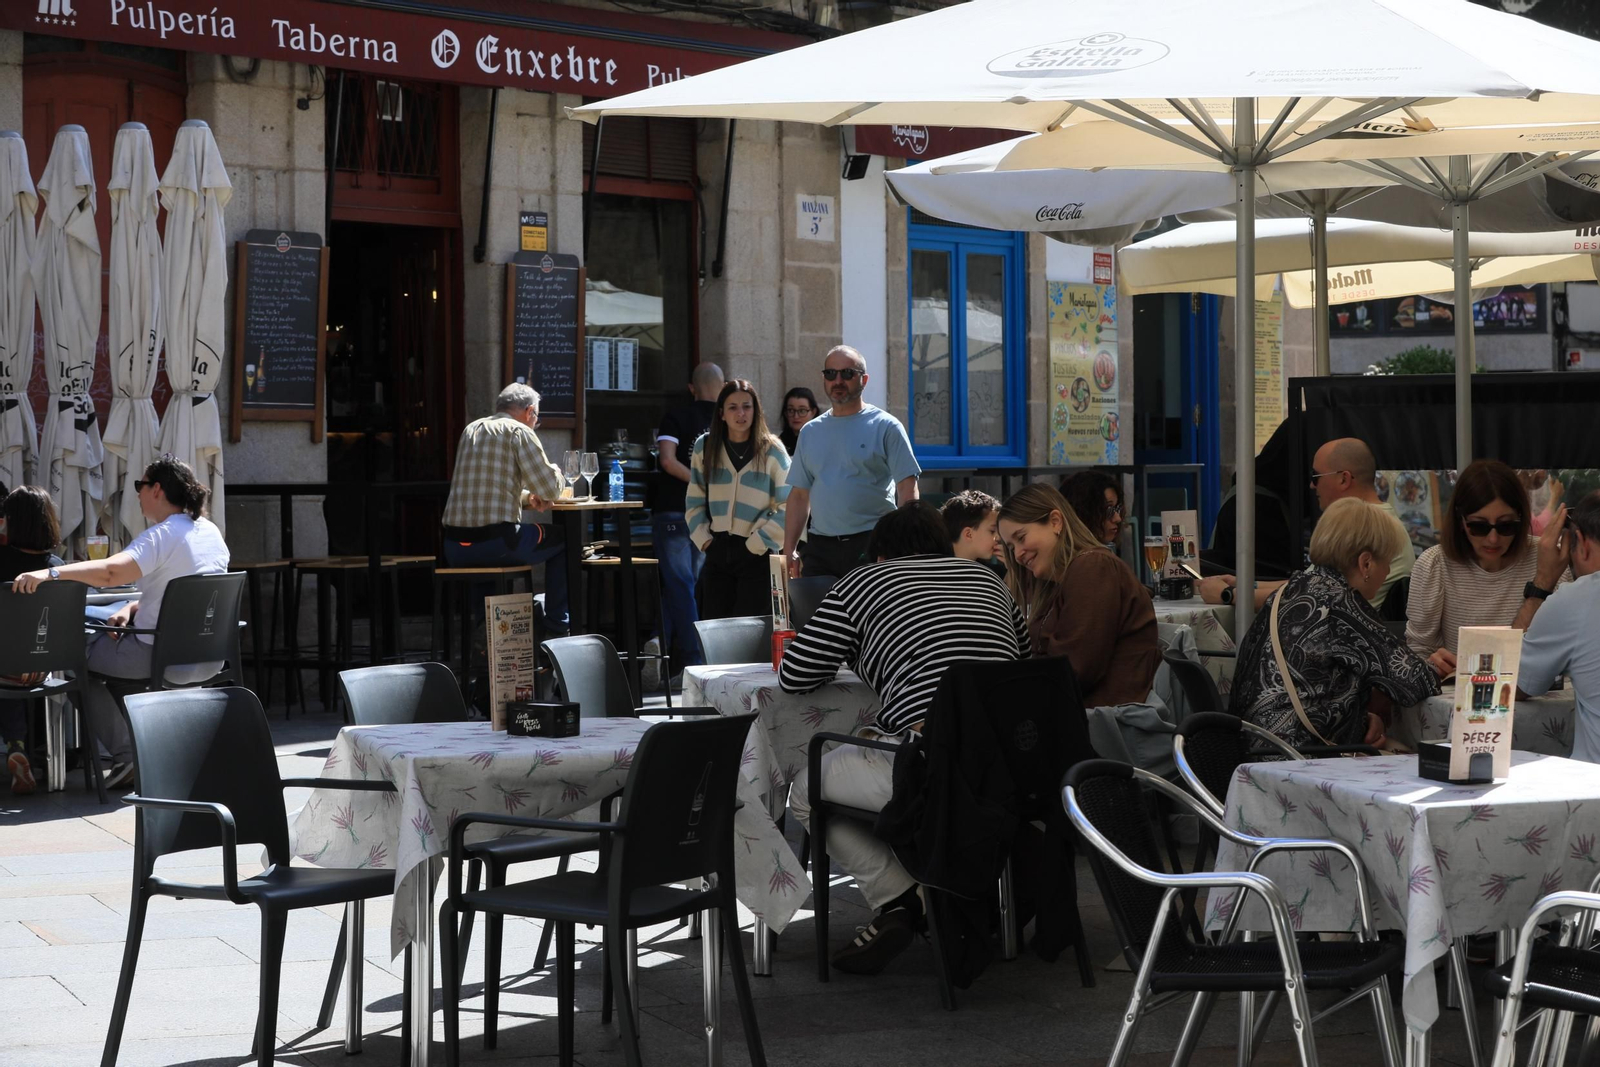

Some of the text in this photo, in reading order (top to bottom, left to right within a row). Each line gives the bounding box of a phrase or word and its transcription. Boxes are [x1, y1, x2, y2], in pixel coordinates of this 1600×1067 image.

[110, 0, 237, 39] Pulpería
[271, 19, 399, 63] Taberna
[430, 28, 461, 69] O
[475, 33, 618, 86] Enxebre
[1026, 46, 1143, 58] Estrella
[1014, 56, 1122, 68] Galicia
[1035, 202, 1087, 222] Coca-Cola
[1574, 242, 1600, 250] DES
[1091, 396, 1117, 404] Raciones
[1069, 413, 1101, 421] Ensaladas
[1067, 428, 1101, 436] Huevos rotos
[1462, 730, 1502, 745] PÉREZ
